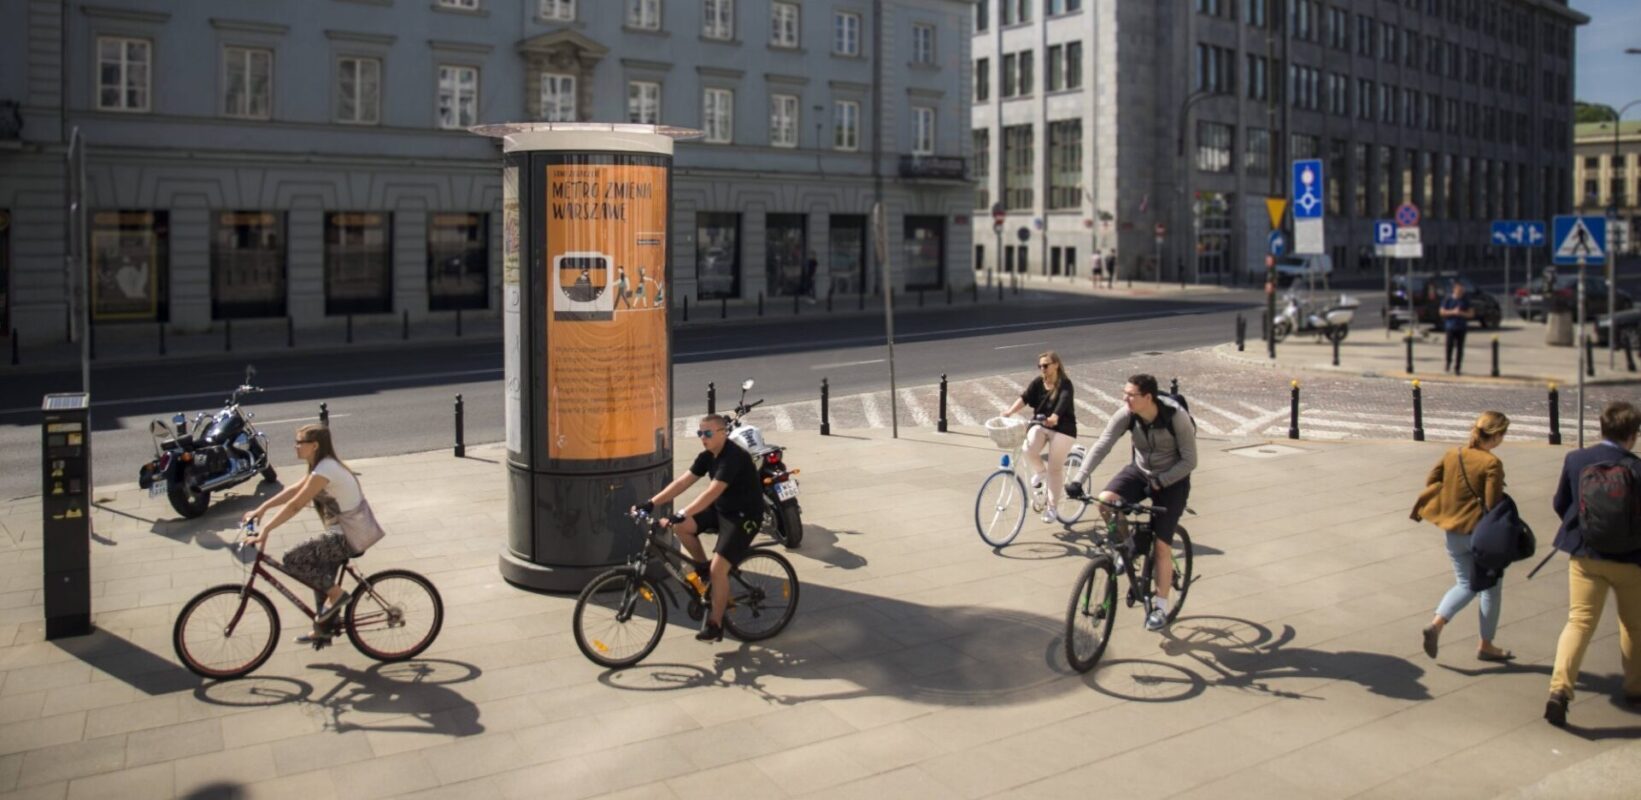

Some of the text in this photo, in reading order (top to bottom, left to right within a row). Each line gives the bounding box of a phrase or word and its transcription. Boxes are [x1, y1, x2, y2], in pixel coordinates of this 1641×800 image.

[552, 181, 652, 200] METRO ZMIENIA
[552, 202, 626, 223] WARSZAWĘ
[1379, 223, 1393, 242] P
